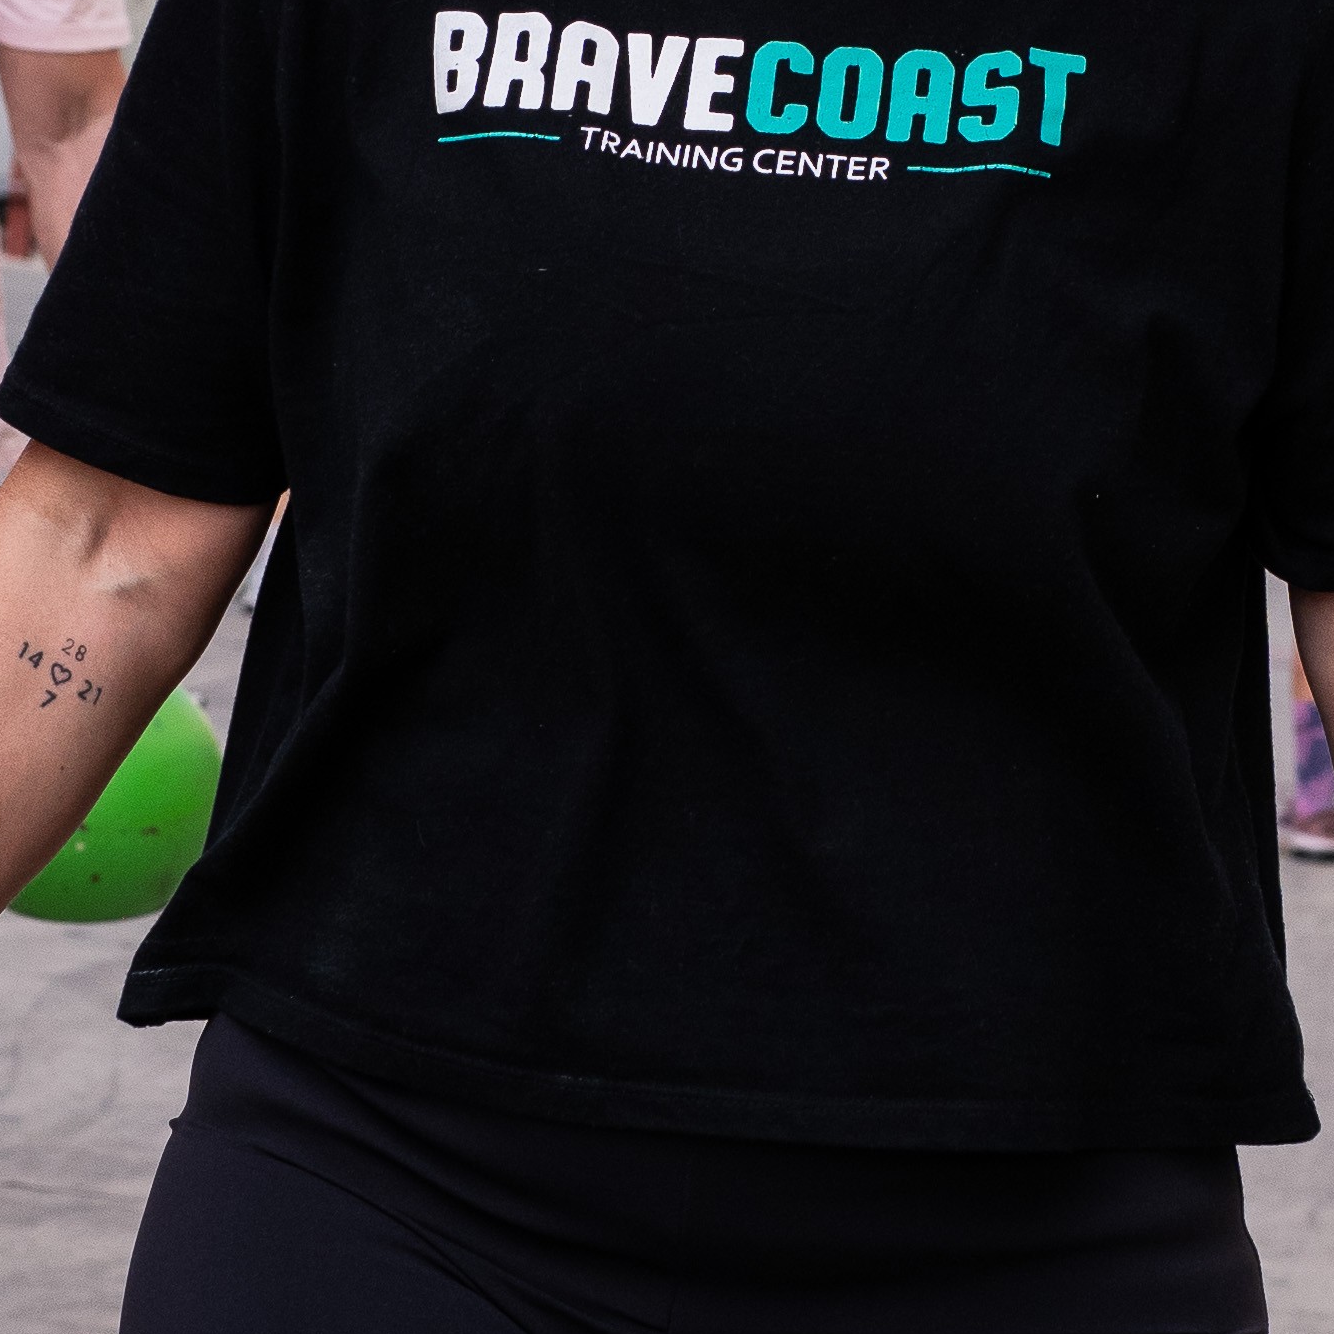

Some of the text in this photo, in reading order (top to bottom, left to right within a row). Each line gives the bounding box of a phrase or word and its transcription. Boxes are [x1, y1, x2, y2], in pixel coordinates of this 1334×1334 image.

[580, 126, 890, 181] TRAINING CENTER
[18, 640, 44, 669] 14
[61, 637, 88, 663] 28
[39, 689, 58, 709] 7
[77, 679, 104, 706] 21
